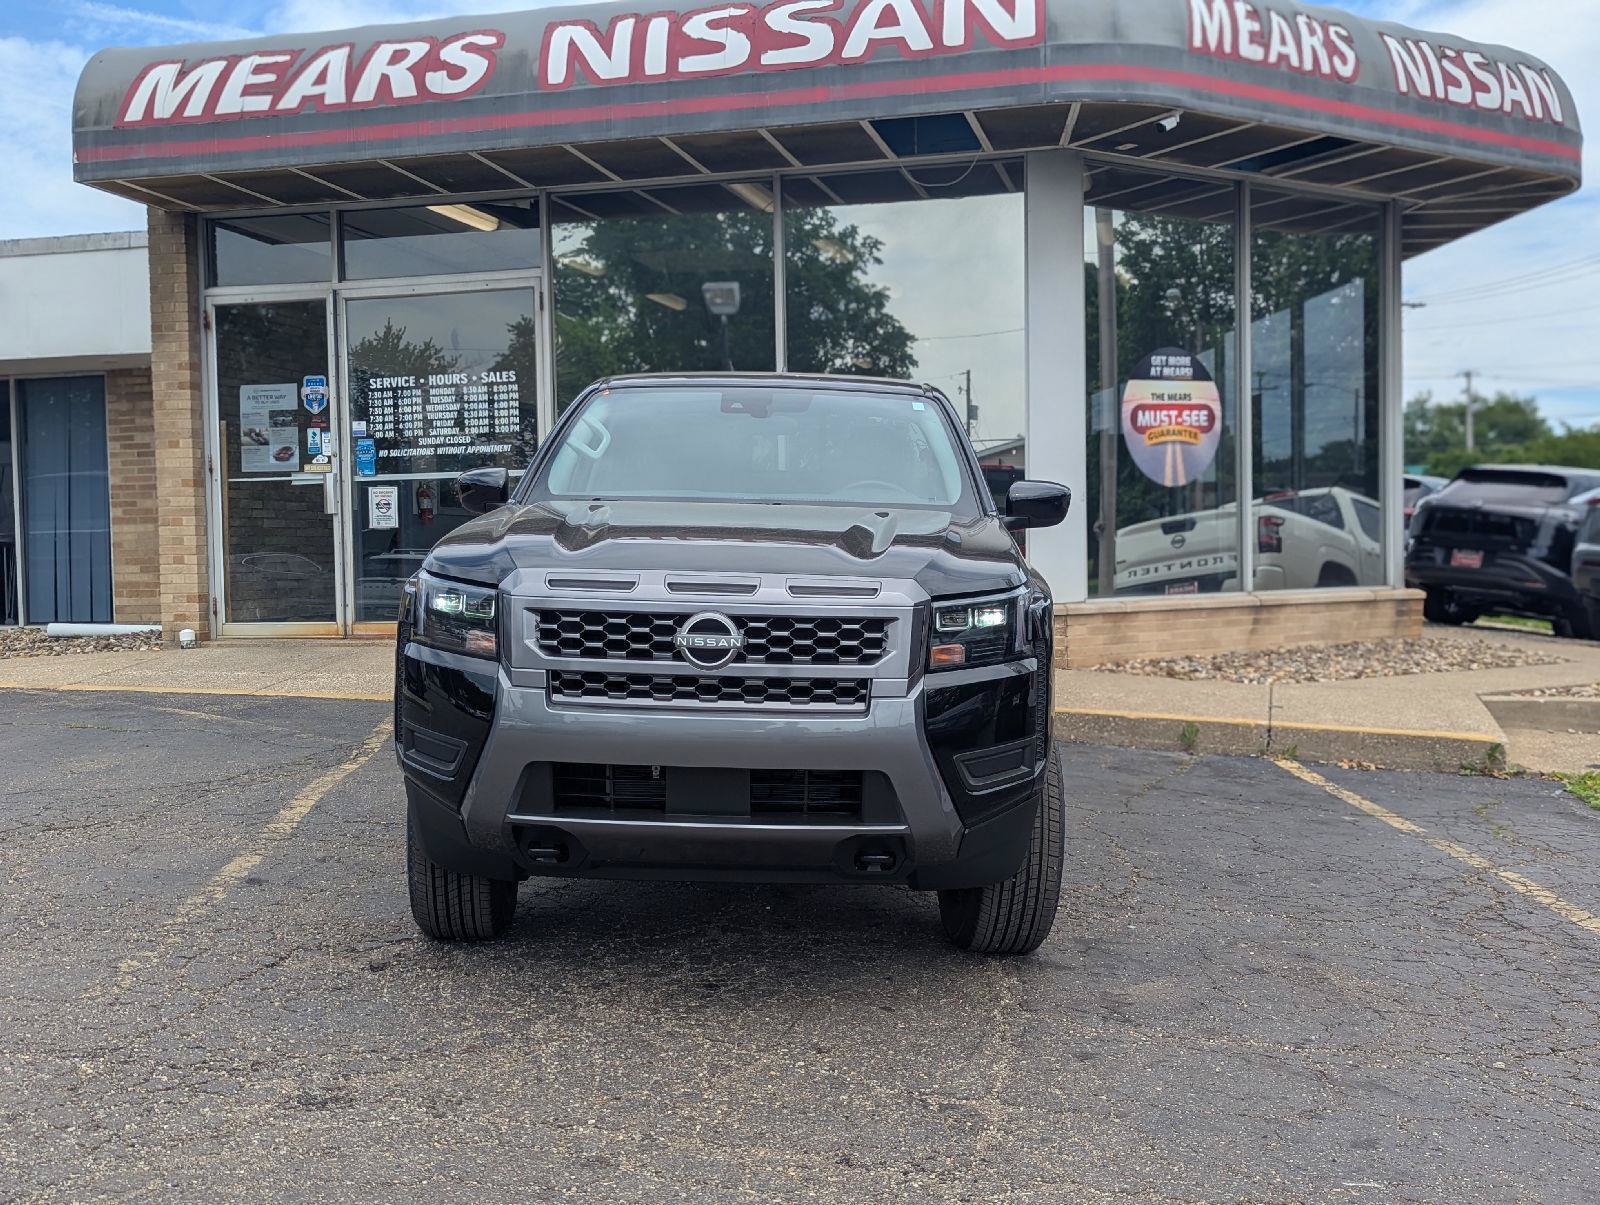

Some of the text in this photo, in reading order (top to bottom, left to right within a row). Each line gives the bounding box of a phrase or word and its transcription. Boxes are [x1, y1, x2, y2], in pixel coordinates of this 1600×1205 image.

[122, 0, 1038, 122] MEARS NISSAN
[1191, 0, 1564, 123] MEARS NISSAN
[1150, 355, 1167, 366] GET
[1150, 366, 1162, 377] AT
[369, 370, 517, 389] SERVICE HOURS SALES
[382, 390, 393, 398] AM
[412, 388, 422, 396] PM
[429, 387, 456, 396] MONDAY
[478, 385, 488, 393] AM
[508, 383, 519, 392] PM
[1150, 392, 1192, 401] THE MEARS
[383, 398, 394, 406] AM
[412, 396, 422, 404] PM
[429, 395, 456, 404] TUESDAY
[478, 393, 489, 401] AM
[509, 391, 519, 400] PM
[383, 406, 394, 415] AM
[412, 404, 423, 413] PM
[425, 403, 461, 412] WEDNESDAY
[478, 401, 489, 410] AM
[509, 400, 520, 408] PM
[384, 414, 395, 422] AM
[413, 412, 423, 420] PM
[426, 411, 458, 420] THURSDAY
[478, 410, 489, 418] AM
[509, 408, 520, 416] PM
[1136, 409, 1209, 427] MUST-SEE
[384, 422, 395, 430] AM
[413, 420, 424, 429] PM
[432, 420, 455, 428] FRIDAY
[479, 418, 490, 426] AM
[509, 416, 520, 424] PM
[384, 430, 395, 438] AM
[413, 428, 424, 437] PM
[429, 427, 460, 436] SATURDAY
[479, 425, 490, 434] AM
[510, 424, 520, 433] PM
[1147, 428, 1199, 441] GUARANTEE
[418, 435, 471, 446] SUNDAY CLOSED
[378, 449, 389, 458] NO
[389, 447, 435, 457] SOLICITATIONS
[436, 445, 466, 455] WITHOUT
[466, 444, 512, 454] APPOINTMENT
[677, 637, 741, 647] NISSAN
